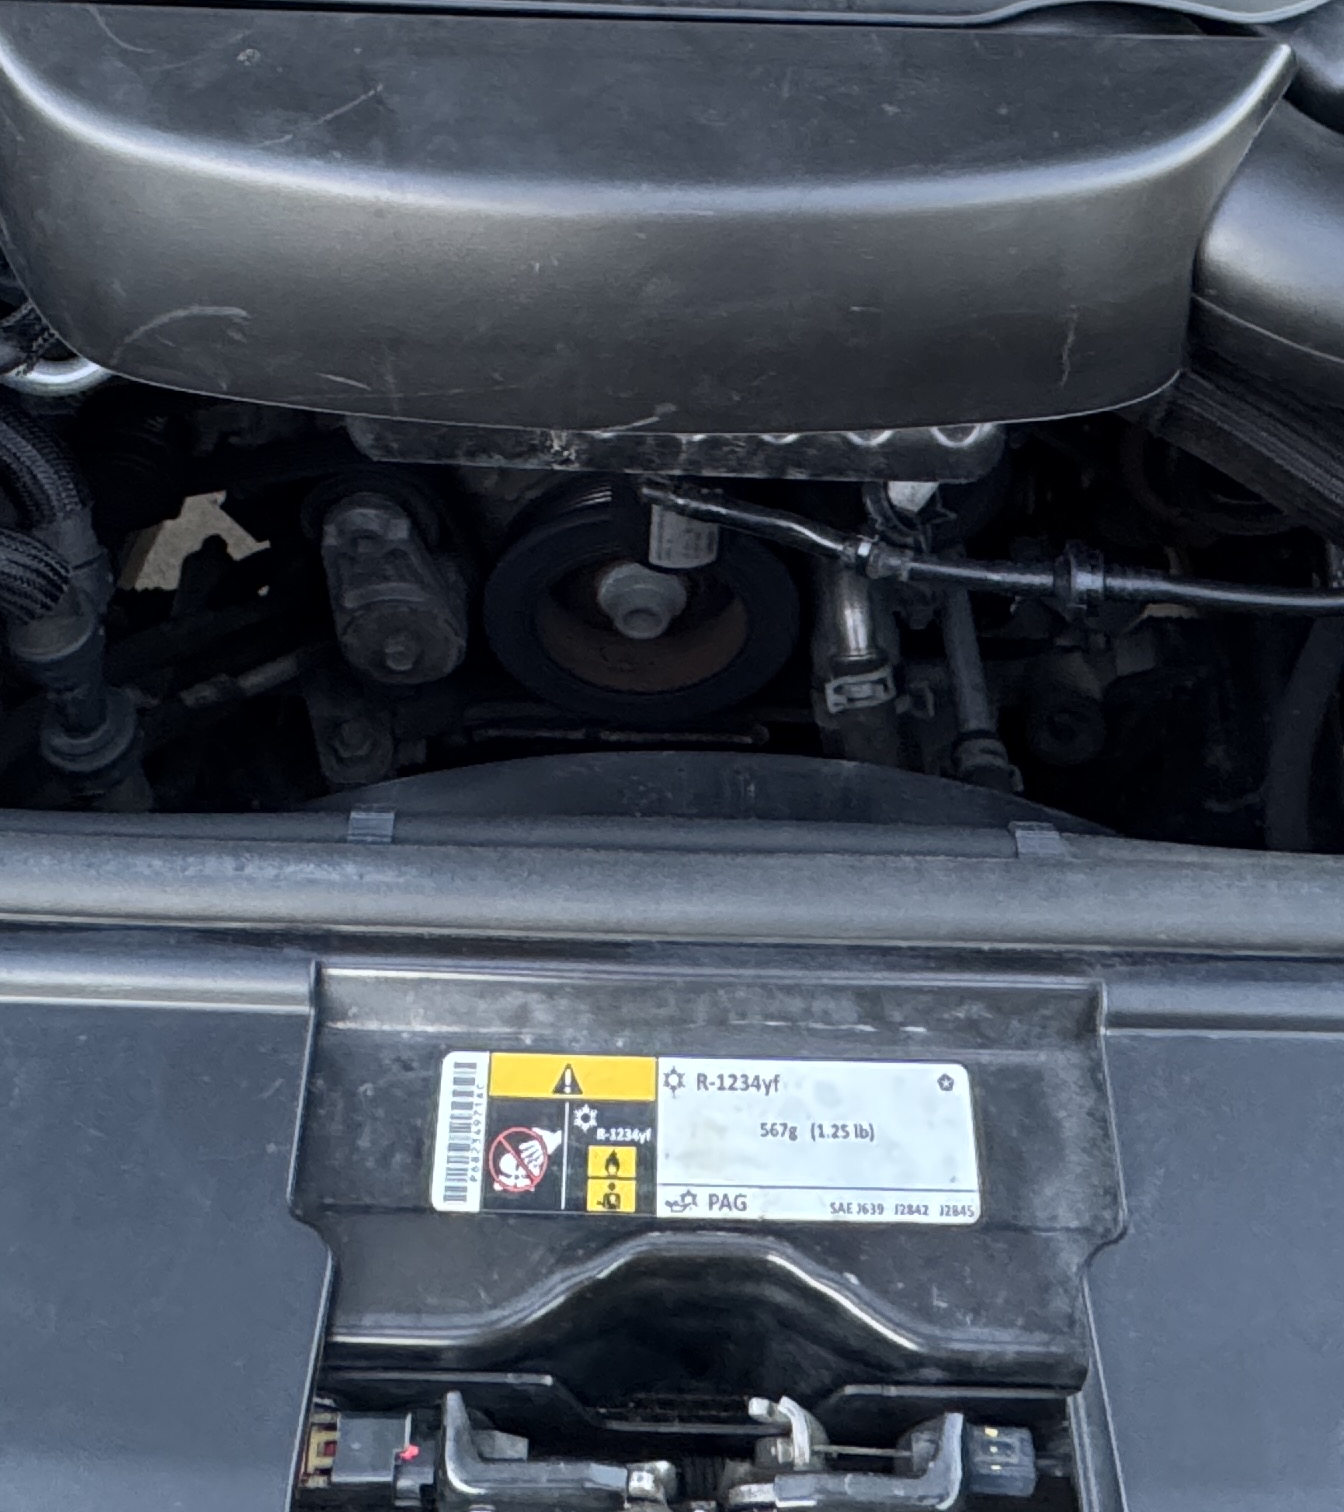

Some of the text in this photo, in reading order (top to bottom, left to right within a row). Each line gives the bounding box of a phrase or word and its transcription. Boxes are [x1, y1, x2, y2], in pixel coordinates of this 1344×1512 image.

[696, 1073, 781, 1096] R-1234yf
[596, 1127, 652, 1143] R-1234yf
[759, 1122, 875, 1141] 567g (1.25 lb)
[708, 1193, 747, 1212] PAG
[830, 1202, 853, 1214] SAE
